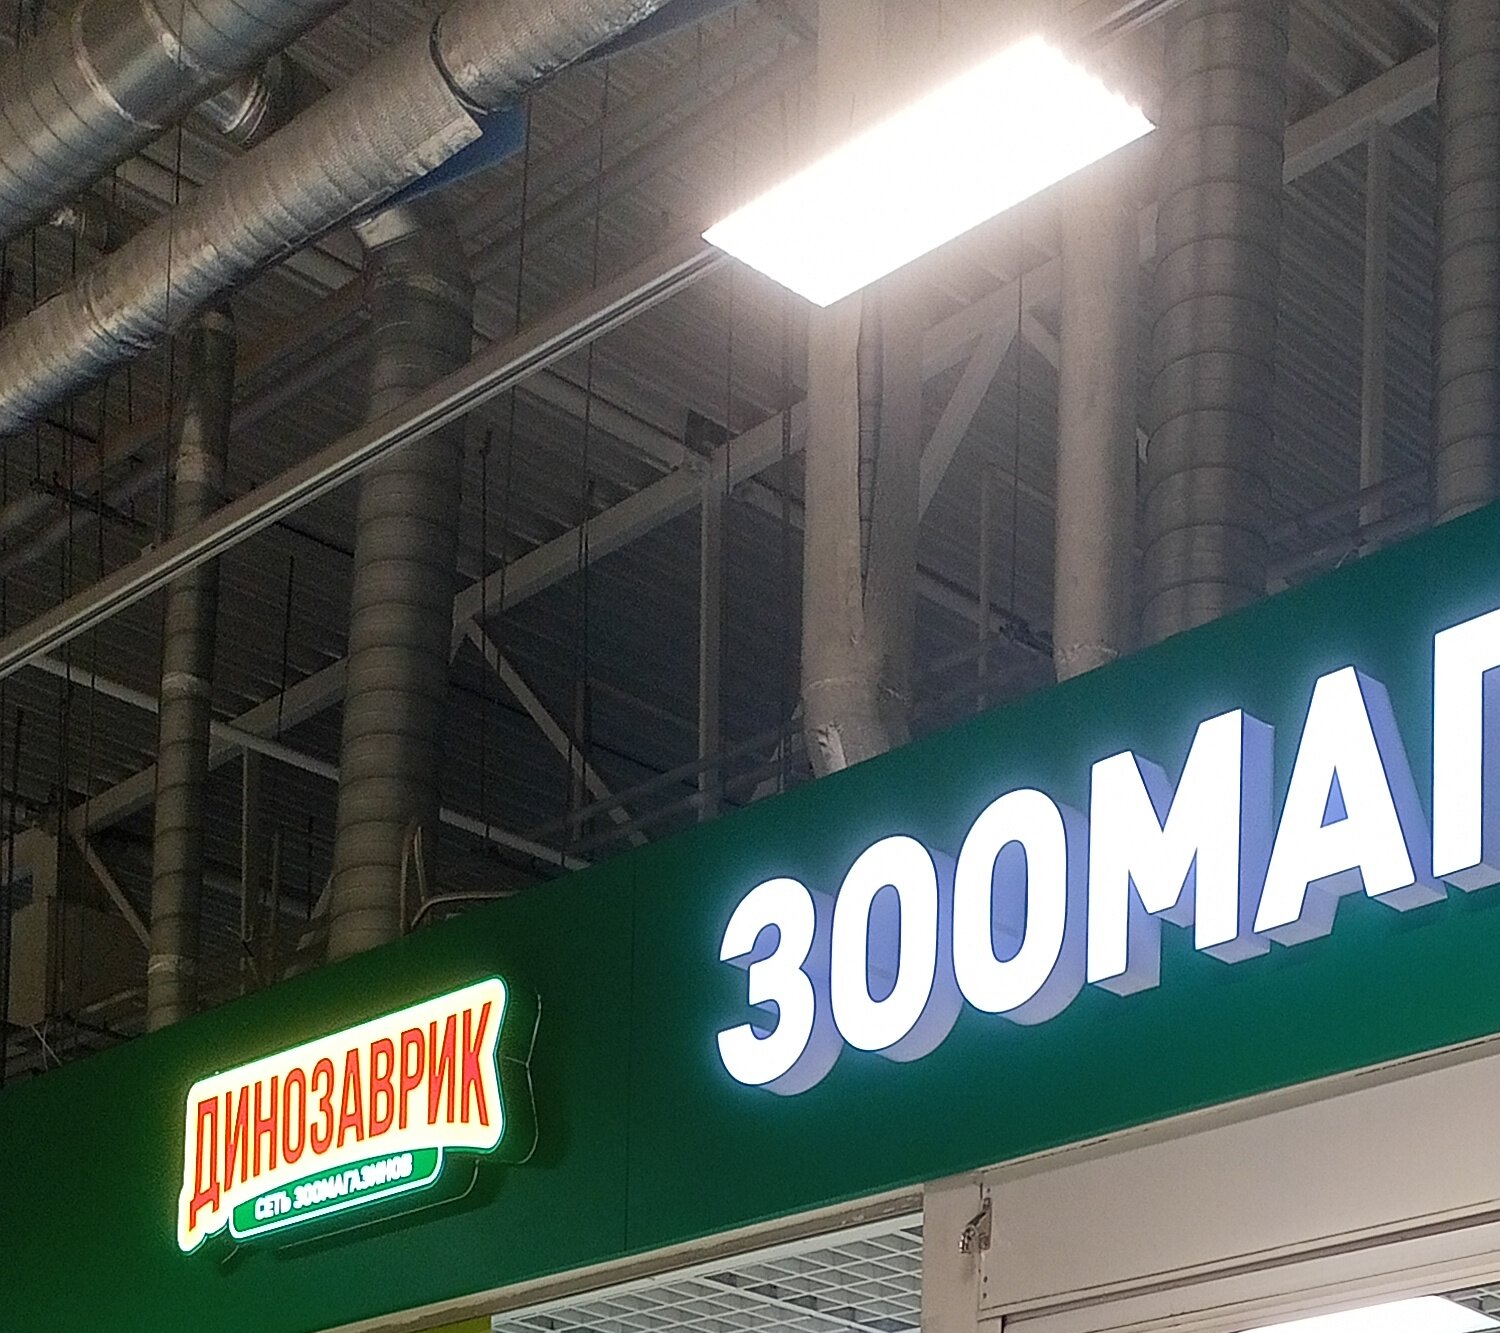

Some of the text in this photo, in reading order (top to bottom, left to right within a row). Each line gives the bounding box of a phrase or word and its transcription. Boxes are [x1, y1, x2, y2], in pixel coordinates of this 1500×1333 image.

[189, 1001, 492, 1232] ДИНОЗАВРИК
[254, 1153, 413, 1221] СЕТЬ ЗООМАГАЗИНОВ
